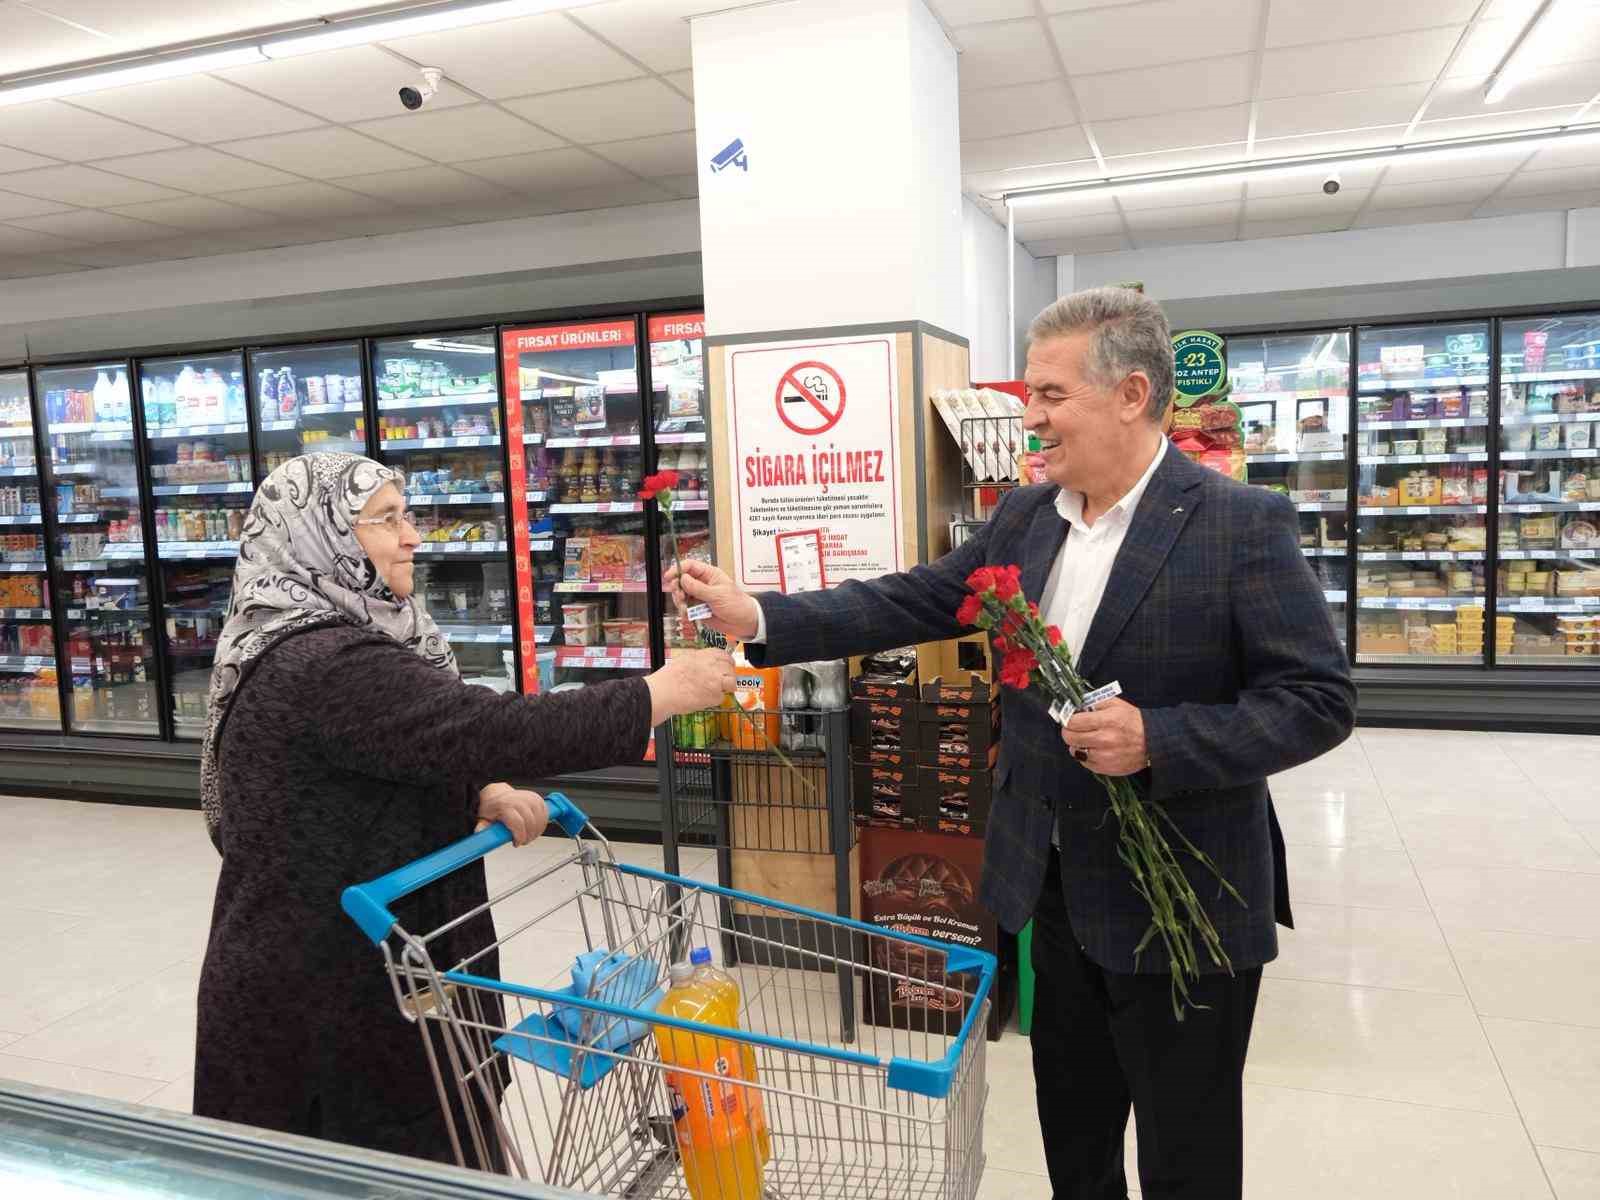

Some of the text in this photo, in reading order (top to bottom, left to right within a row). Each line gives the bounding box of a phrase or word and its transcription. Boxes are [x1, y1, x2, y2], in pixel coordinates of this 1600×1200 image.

[517, 330, 622, 348] FIRSAT ÜRÜNLERİ
[1190, 337, 1217, 347] HASAT
[1191, 368, 1220, 377] ANTEP
[1177, 378, 1212, 386] FISTIKLI
[745, 443, 885, 493] SİGARA İÇİLMEZ
[752, 528, 777, 537] Şikayet
